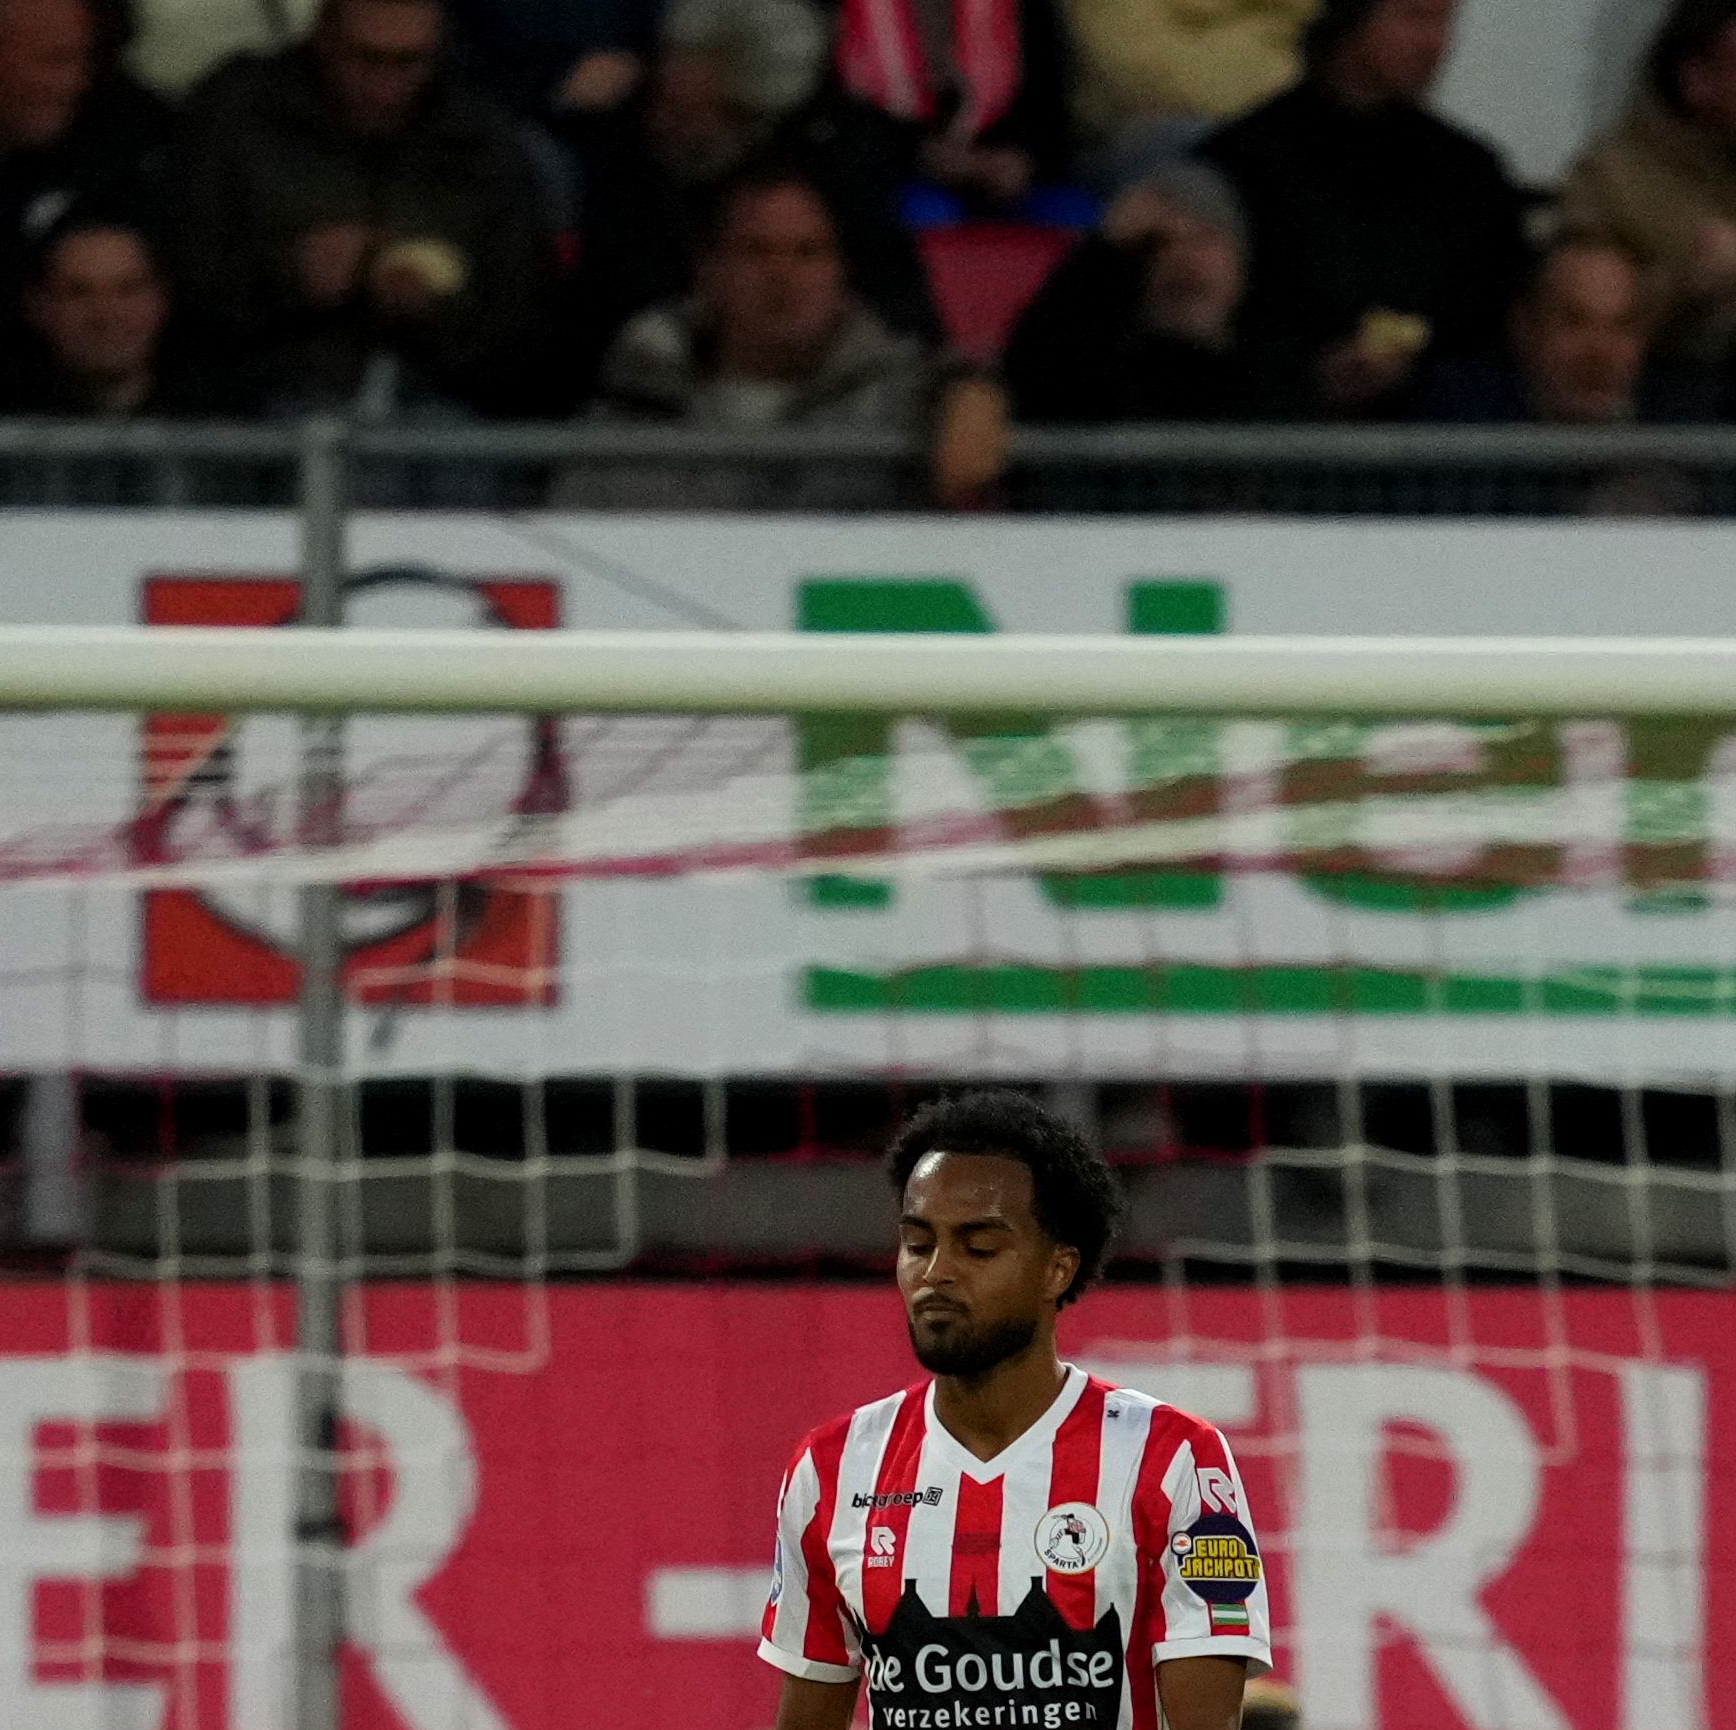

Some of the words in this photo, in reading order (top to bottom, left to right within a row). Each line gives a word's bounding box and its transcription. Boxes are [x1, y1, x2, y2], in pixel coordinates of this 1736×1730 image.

[1044, 1548, 1080, 1570] SPARTA
[1195, 1538, 1241, 1559] EURO
[869, 1644, 905, 1692] de
[915, 1638, 1115, 1694] Goudse
[882, 1699, 1098, 1729] verzekeringen
